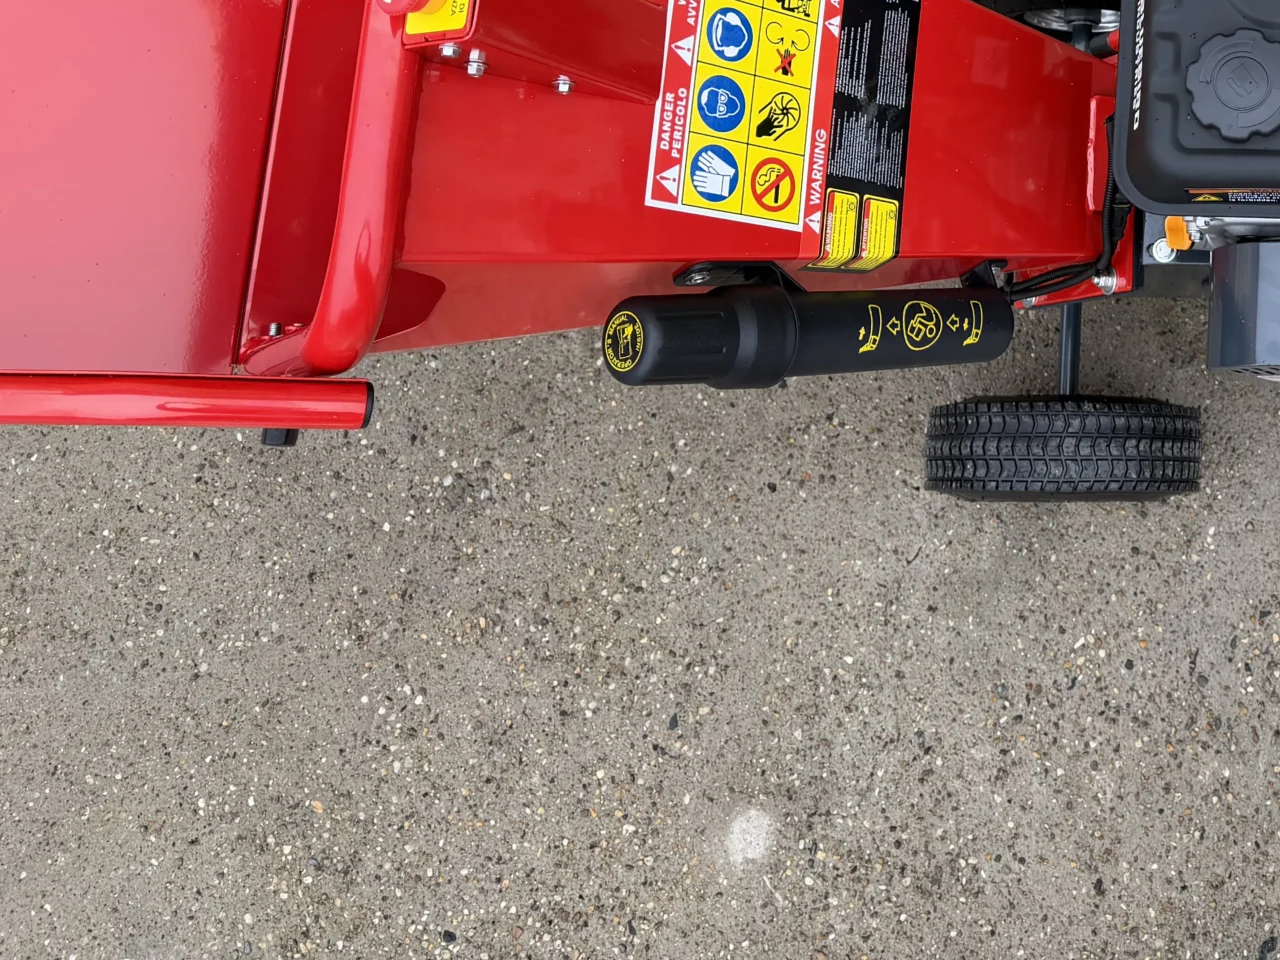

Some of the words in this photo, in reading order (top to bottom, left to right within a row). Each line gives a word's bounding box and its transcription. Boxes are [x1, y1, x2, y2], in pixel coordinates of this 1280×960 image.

[458, 3, 466, 13] DI
[660, 92, 675, 150] DANGER
[671, 88, 687, 158] PERICOLO
[809, 128, 827, 205] WARNING
[825, 212, 833, 244] WARNING
